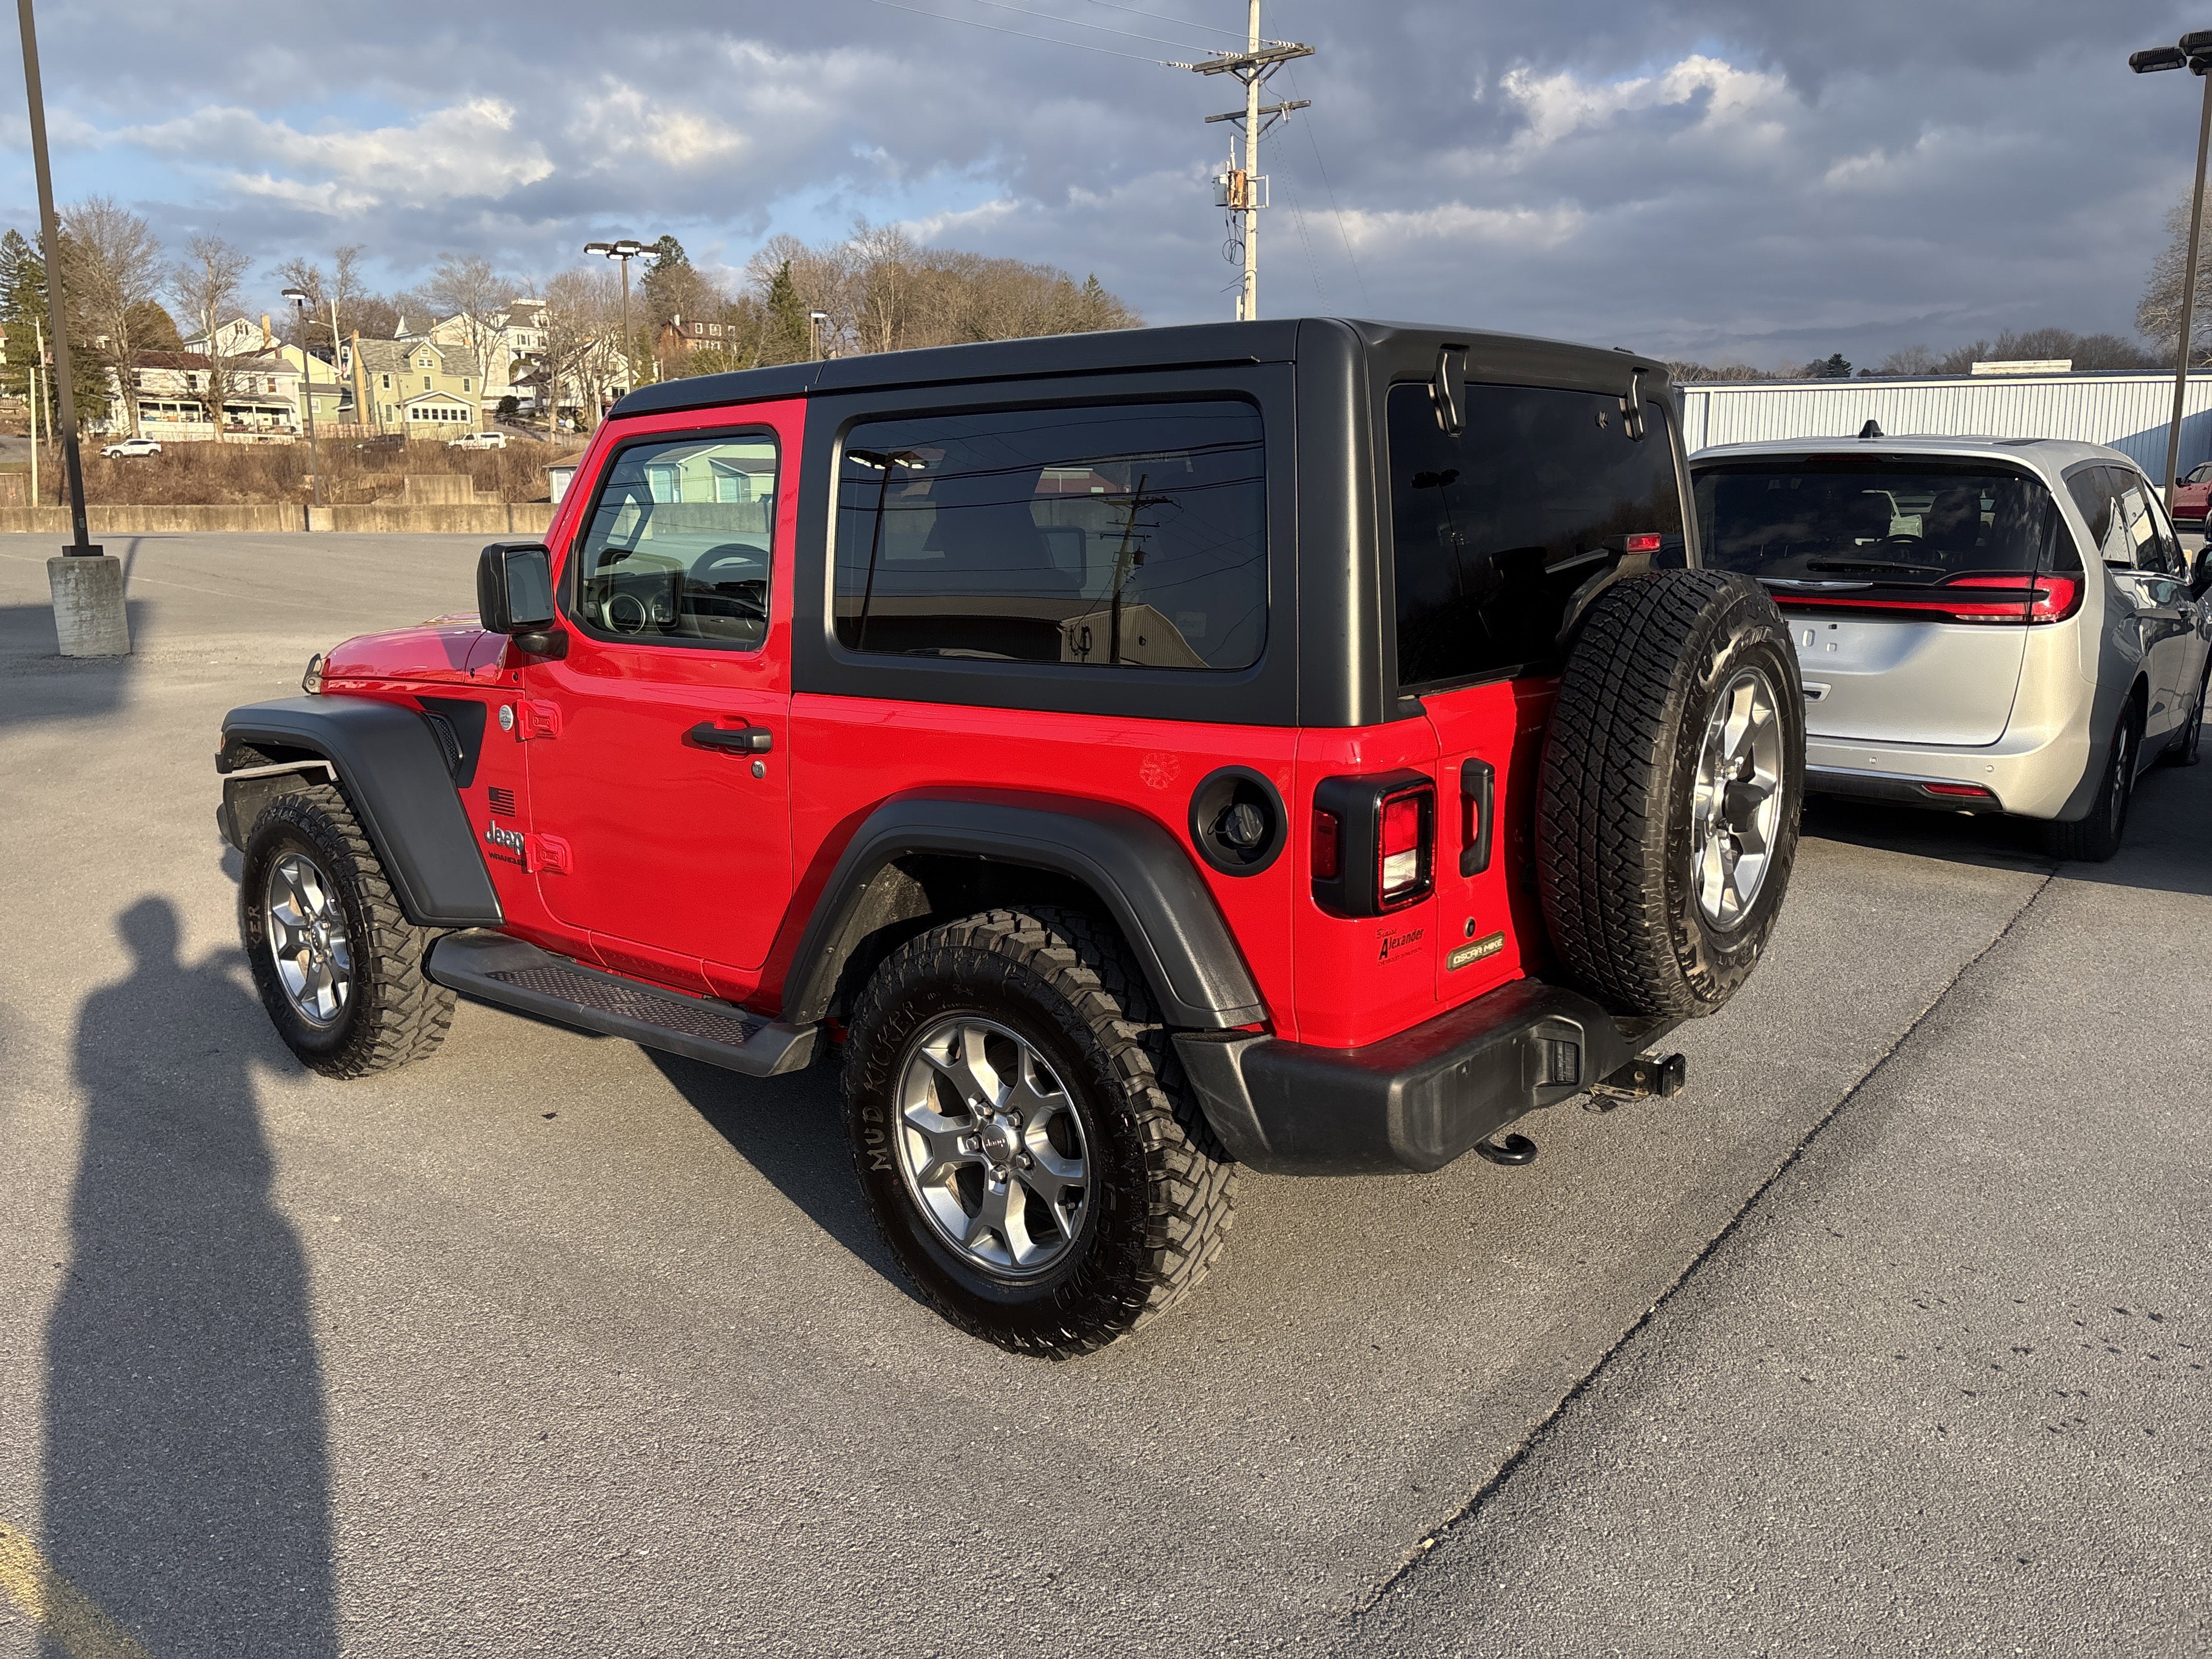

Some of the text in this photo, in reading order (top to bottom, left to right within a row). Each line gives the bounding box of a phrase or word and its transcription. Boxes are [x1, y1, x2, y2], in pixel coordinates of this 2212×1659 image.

[484, 820, 525, 856] Jeep
[1379, 927, 1425, 961] Alexander
[1453, 938, 1503, 964] OSCAR MIKE
[863, 1000, 926, 1172] MUD KICKER
